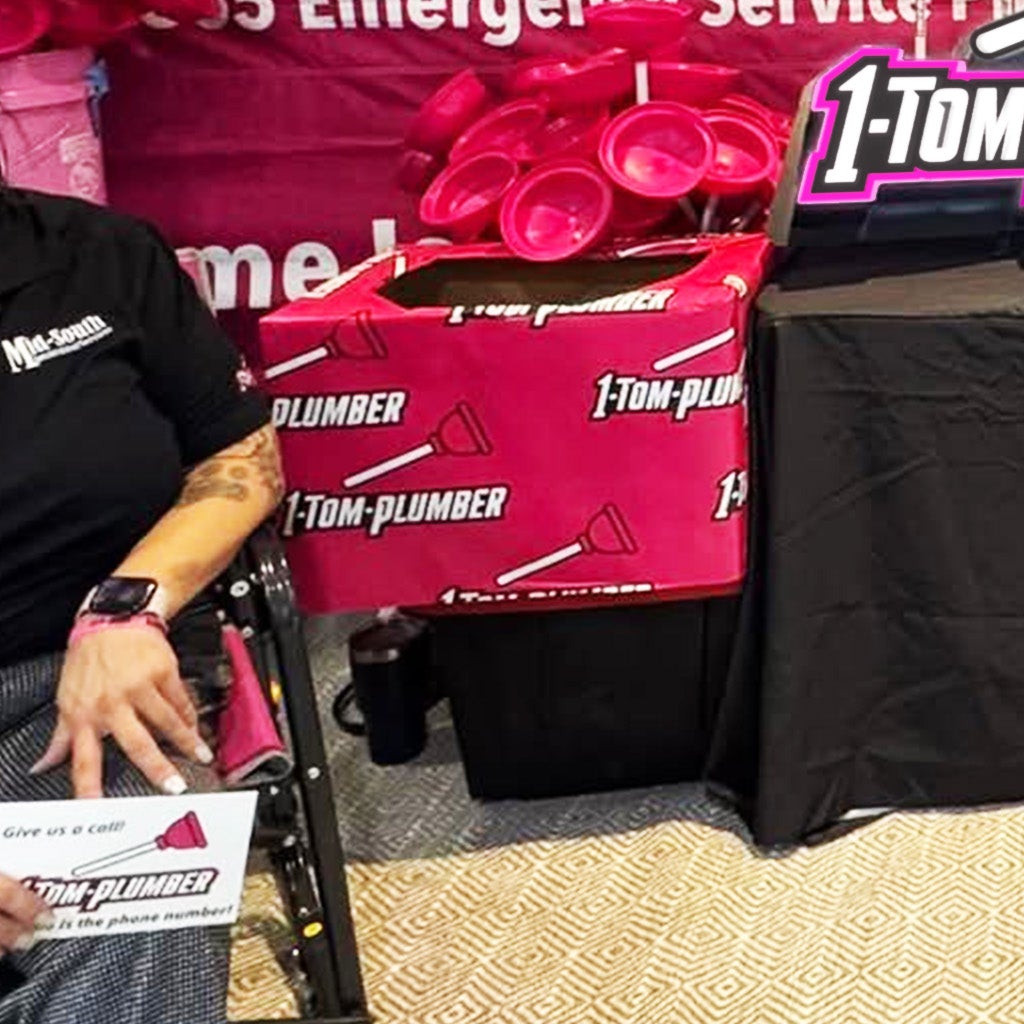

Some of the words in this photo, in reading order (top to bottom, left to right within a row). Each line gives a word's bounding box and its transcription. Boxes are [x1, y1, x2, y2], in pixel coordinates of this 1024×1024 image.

[283, 487, 508, 536] 1-TOM-PLUMBER
[3, 826, 42, 838] Give
[47, 825, 66, 836] us
[78, 916, 104, 927] the
[107, 913, 160, 929] phone
[164, 905, 233, 920] number!
